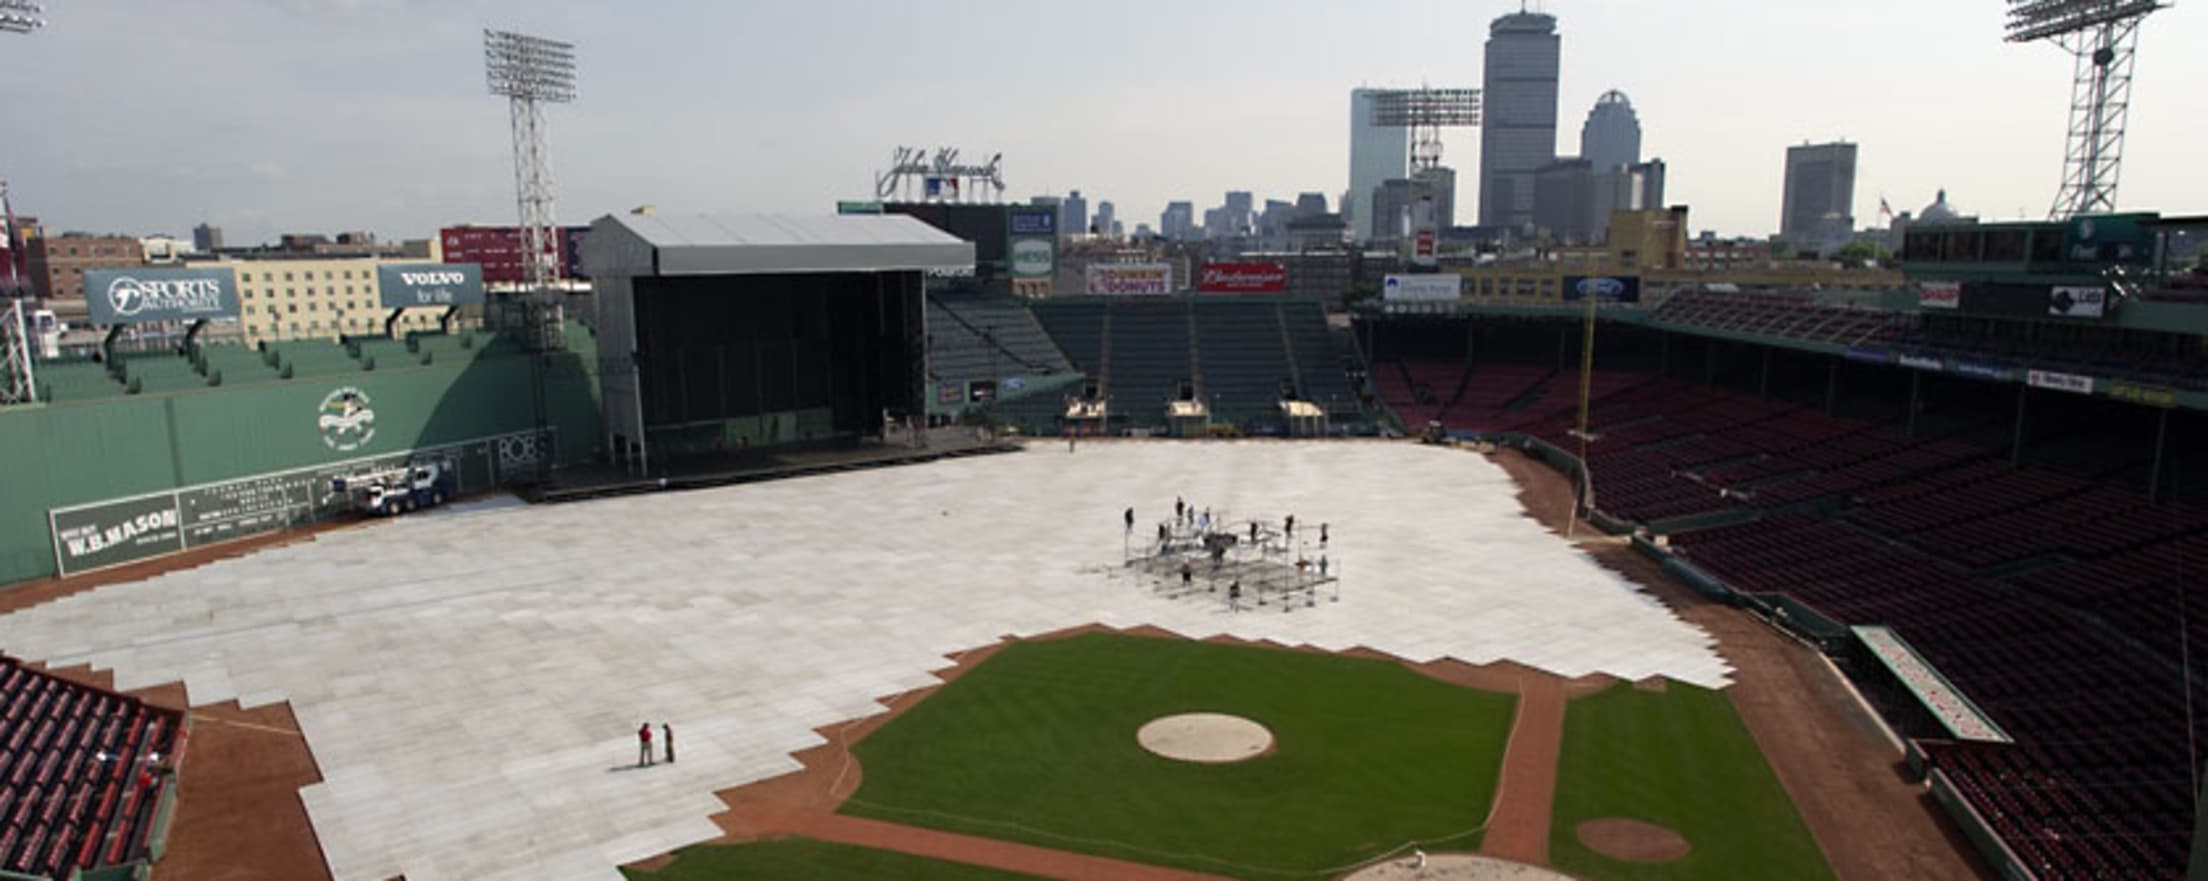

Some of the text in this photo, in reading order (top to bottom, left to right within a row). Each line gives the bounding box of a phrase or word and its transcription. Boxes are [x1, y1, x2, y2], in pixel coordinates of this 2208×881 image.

[933, 145, 1005, 191] Hancock
[401, 272, 464, 285] VOLVO
[1202, 269, 1284, 283] Budweiser
[141, 279, 220, 299] SPORTS
